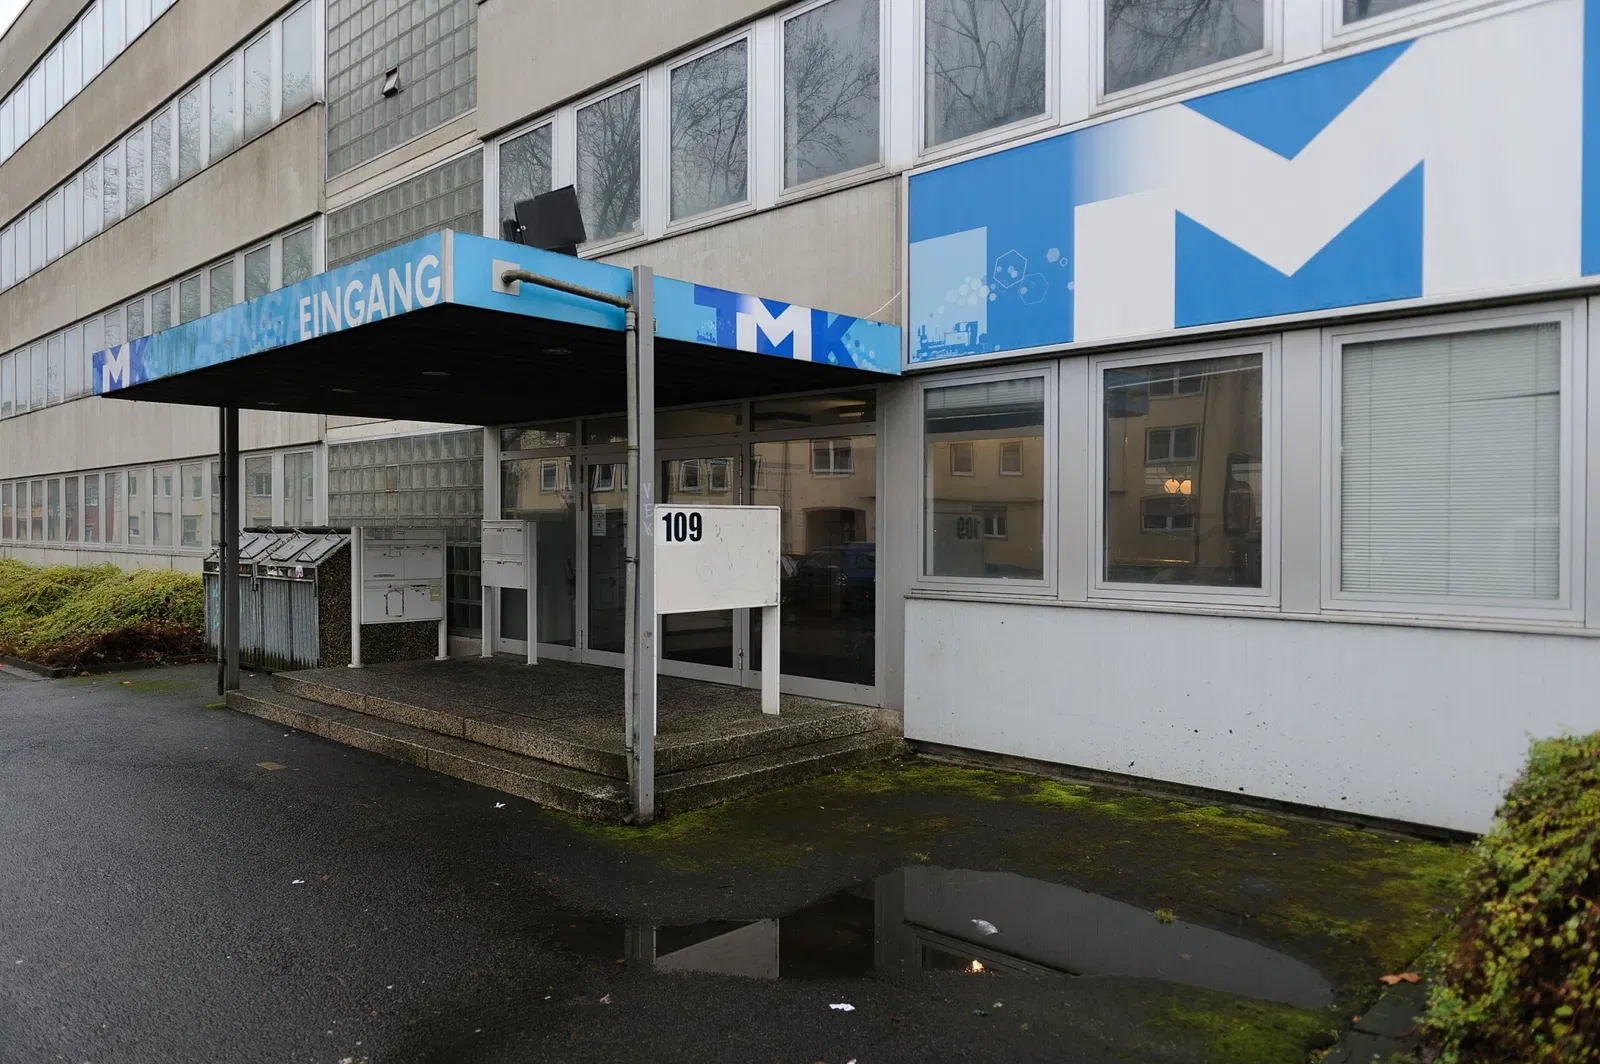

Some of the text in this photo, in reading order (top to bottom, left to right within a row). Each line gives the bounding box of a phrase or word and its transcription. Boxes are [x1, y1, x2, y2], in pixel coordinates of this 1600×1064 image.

[909, 0, 1600, 342] TM
[300, 254, 441, 342] EINGANG
[694, 283, 859, 369] TMK
[662, 512, 703, 542] 109
